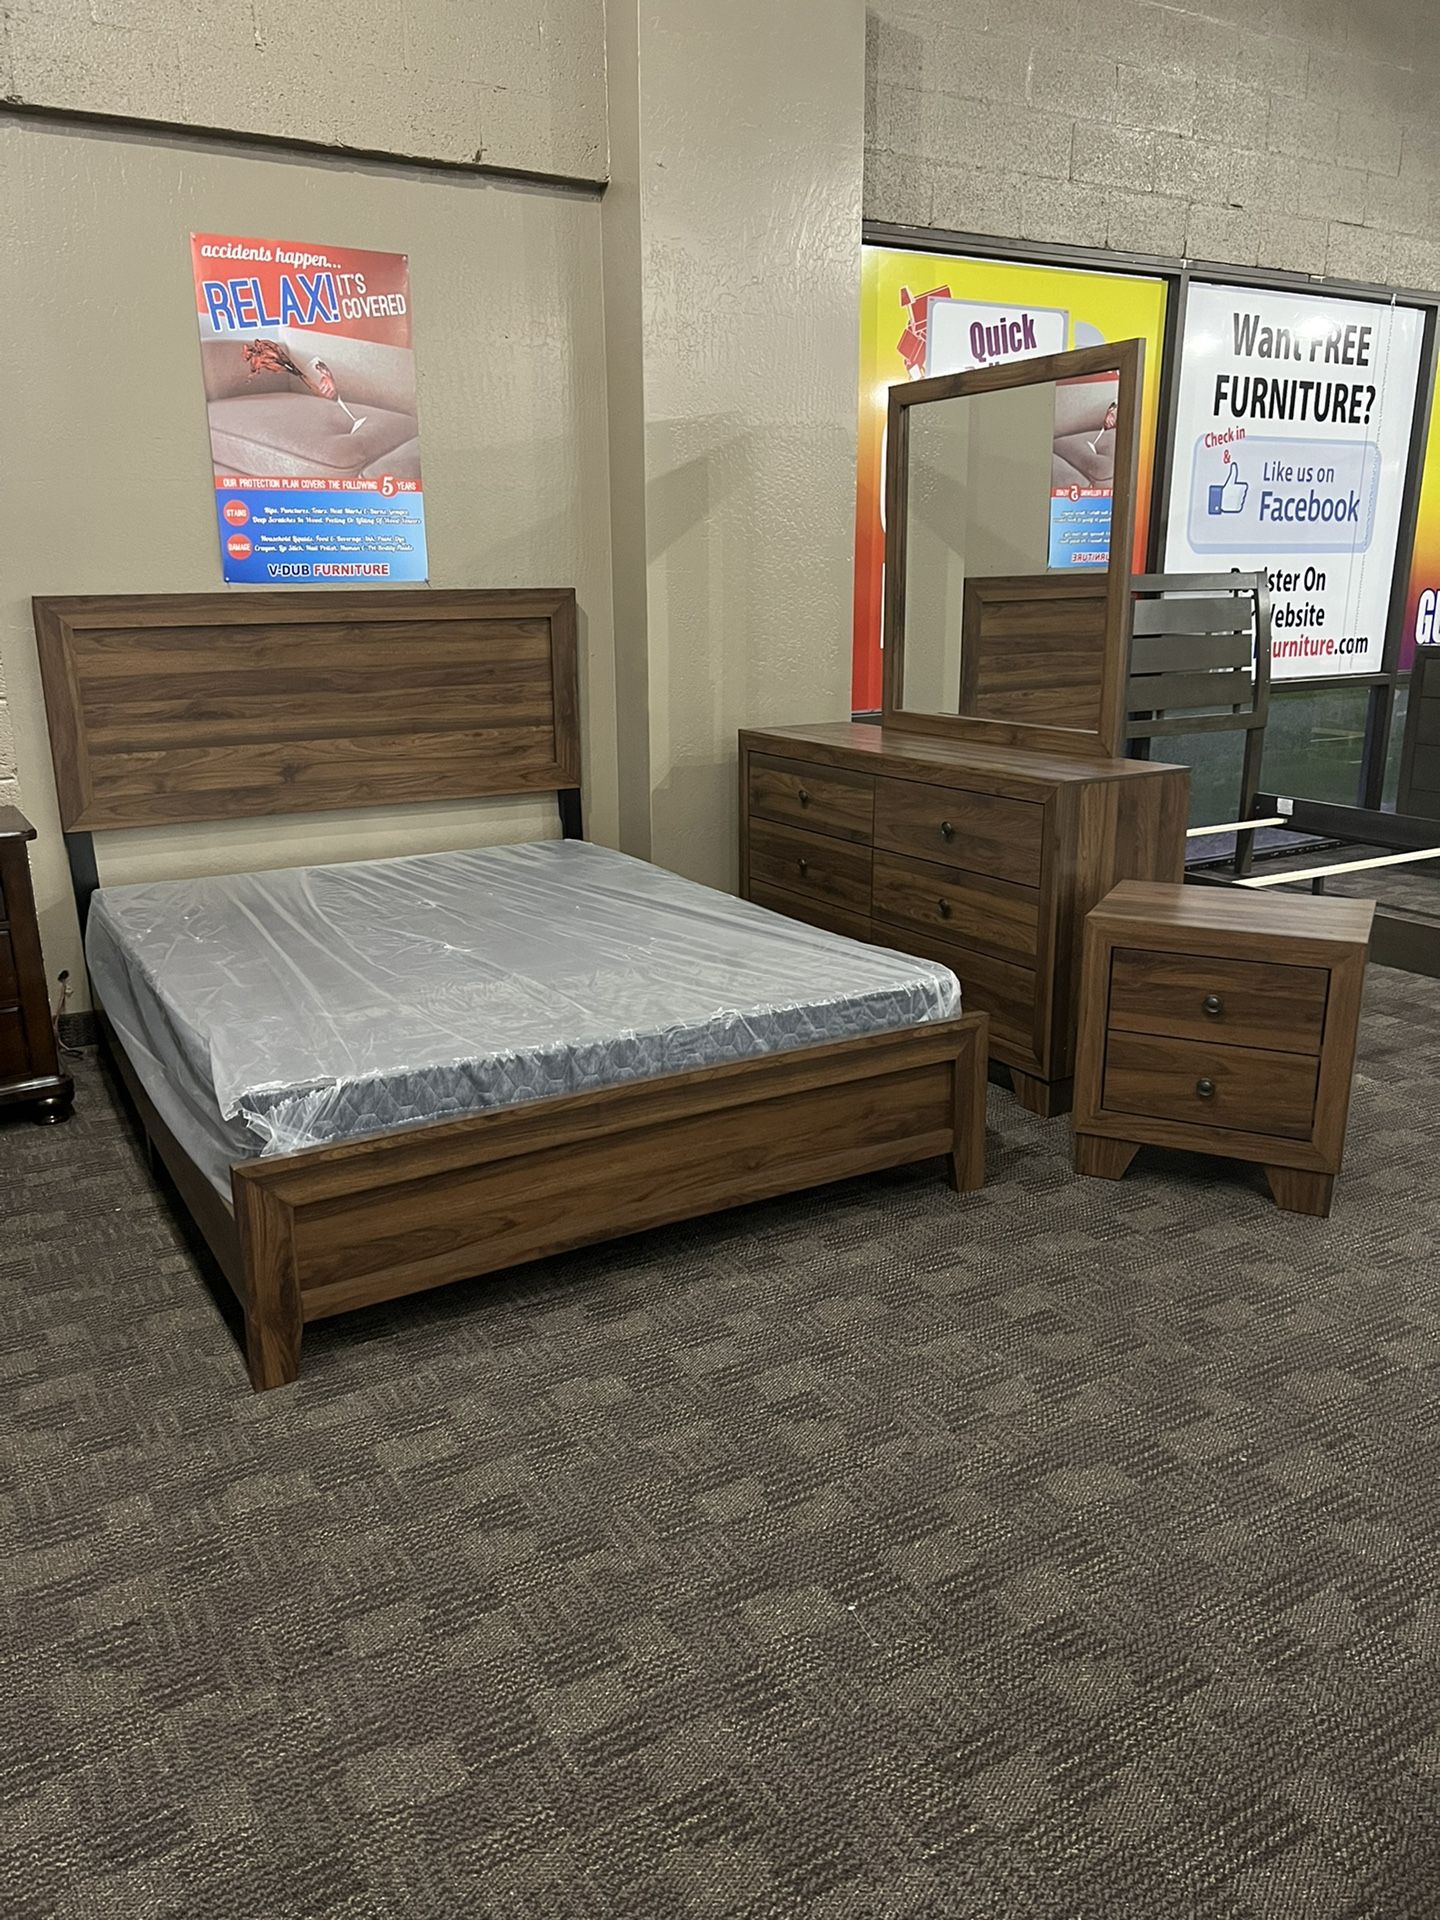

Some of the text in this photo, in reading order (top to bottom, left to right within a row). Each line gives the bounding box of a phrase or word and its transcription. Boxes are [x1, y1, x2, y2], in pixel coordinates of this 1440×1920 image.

[201, 243, 342, 269] accidents happen...
[336, 273, 367, 296] IT'S
[203, 272, 341, 333] RELAX!
[342, 294, 407, 320] COVERED
[969, 313, 1037, 363] Quick
[1309, 324, 1372, 366] FREE
[1213, 374, 1376, 425] FURNITURE?
[1204, 425, 1246, 448] Check in
[1223, 449, 1231, 464] &
[1263, 461, 1334, 483] Like us on
[223, 476, 417, 496] OUR PROTECTION PLAN COVERS THE FOLLOWING 5 YEARS
[226, 508, 247, 518] STAINS
[1259, 489, 1360, 522] Facebook
[228, 543, 251, 552] DAMAGE
[268, 563, 391, 577] V-DUB FURNITURE
[1304, 566, 1326, 591] On
